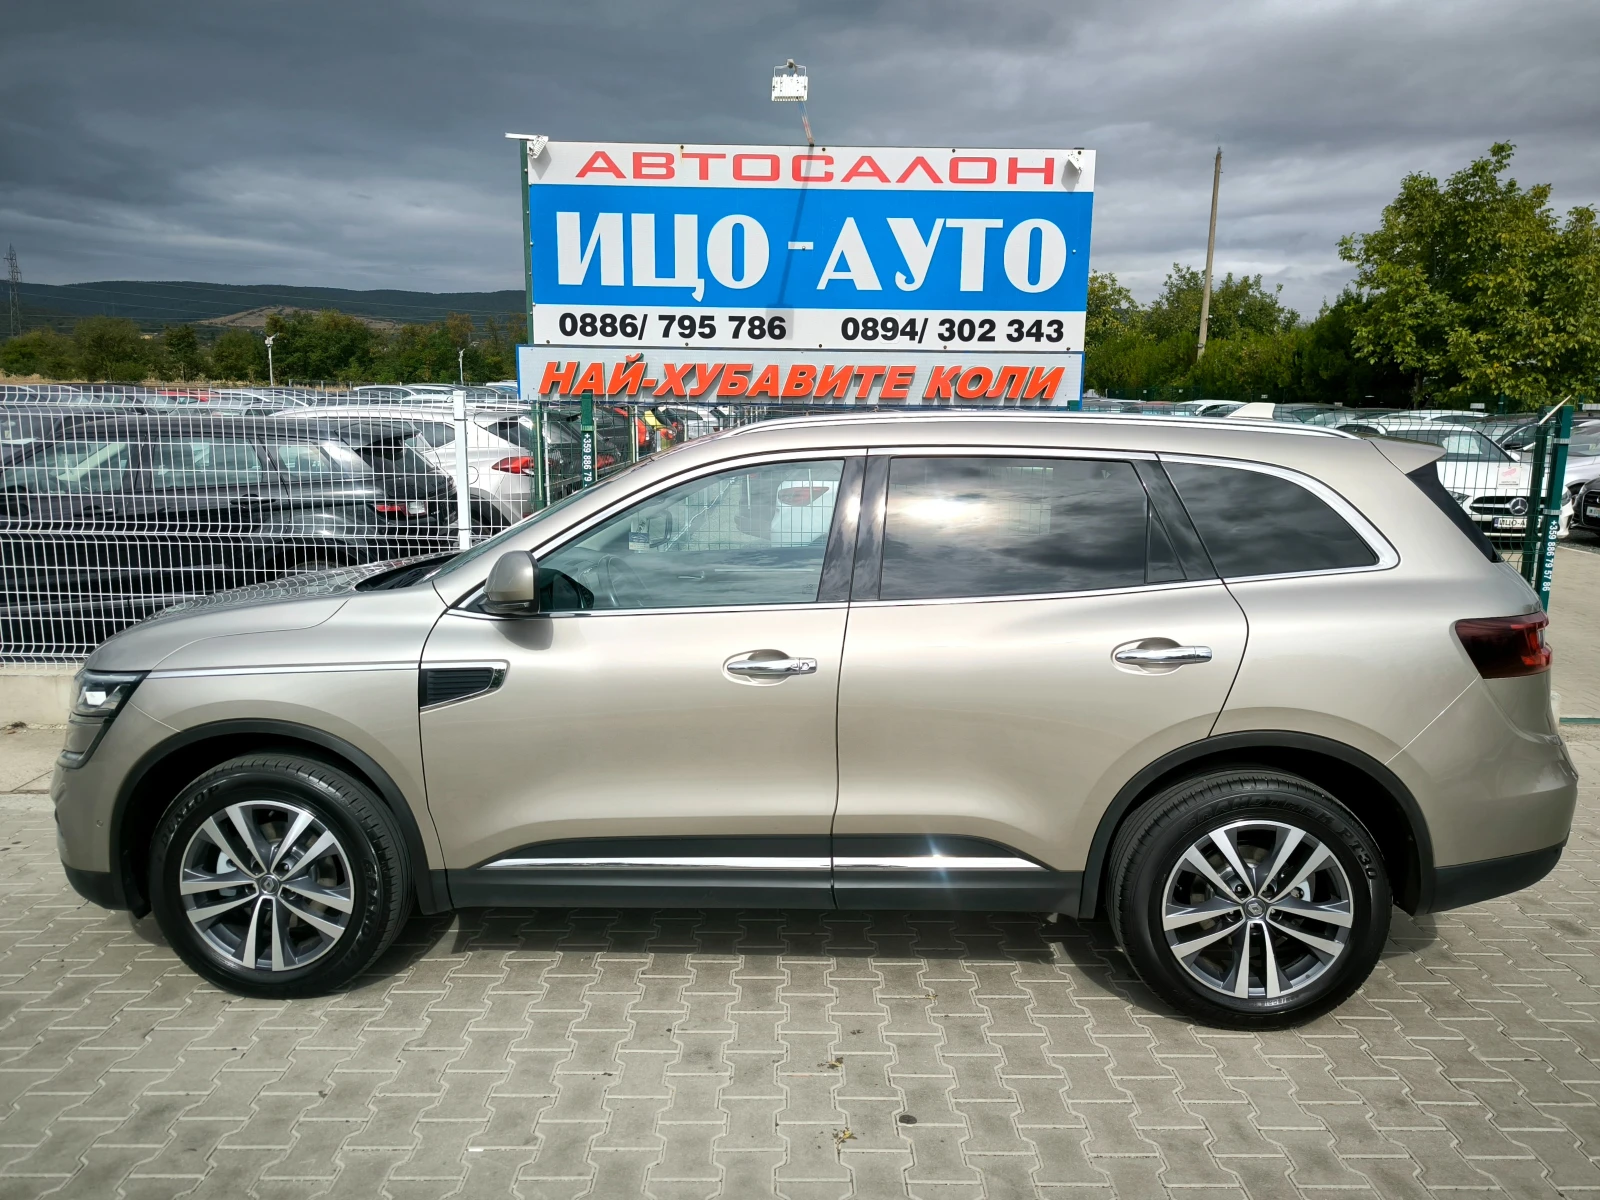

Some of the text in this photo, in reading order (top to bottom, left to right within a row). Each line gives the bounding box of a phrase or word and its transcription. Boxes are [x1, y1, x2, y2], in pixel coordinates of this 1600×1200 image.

[576, 151, 1055, 185] АВТОСАЛОН
[559, 313, 787, 340] 0886/ 795 786
[841, 317, 1064, 344] 0894/ 302 343
[538, 353, 1067, 400] НАЙ-ХУБАВИТЕ КОЛИ
[583, 433, 592, 453] +359
[583, 455, 592, 469] 886
[584, 472, 592, 482] 79
[1542, 520, 1558, 592] +359 886 79 57 86
[160, 784, 220, 847] DUNLOP
[1336, 827, 1377, 879] PT30
